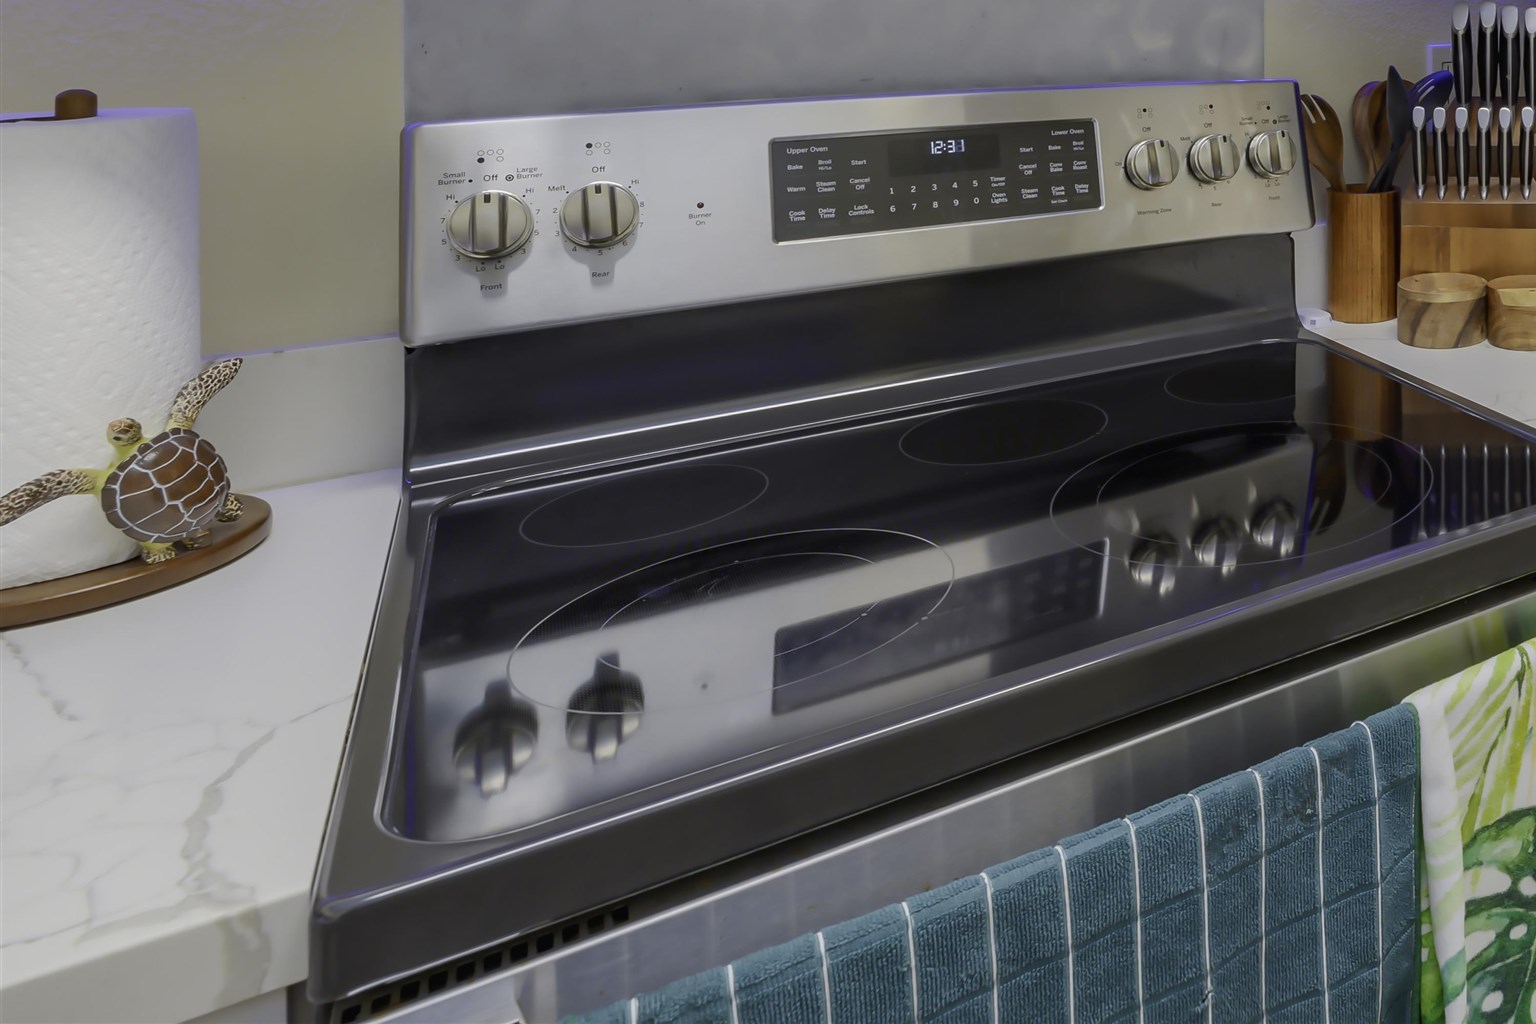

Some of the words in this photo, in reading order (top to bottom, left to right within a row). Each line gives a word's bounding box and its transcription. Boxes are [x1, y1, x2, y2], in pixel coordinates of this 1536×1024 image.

[786, 147, 809, 155] Upper
[930, 139, 965, 155] 12:31
[438, 178, 466, 186] Burner
[483, 174, 498, 182] Off
[480, 283, 502, 291] Front
